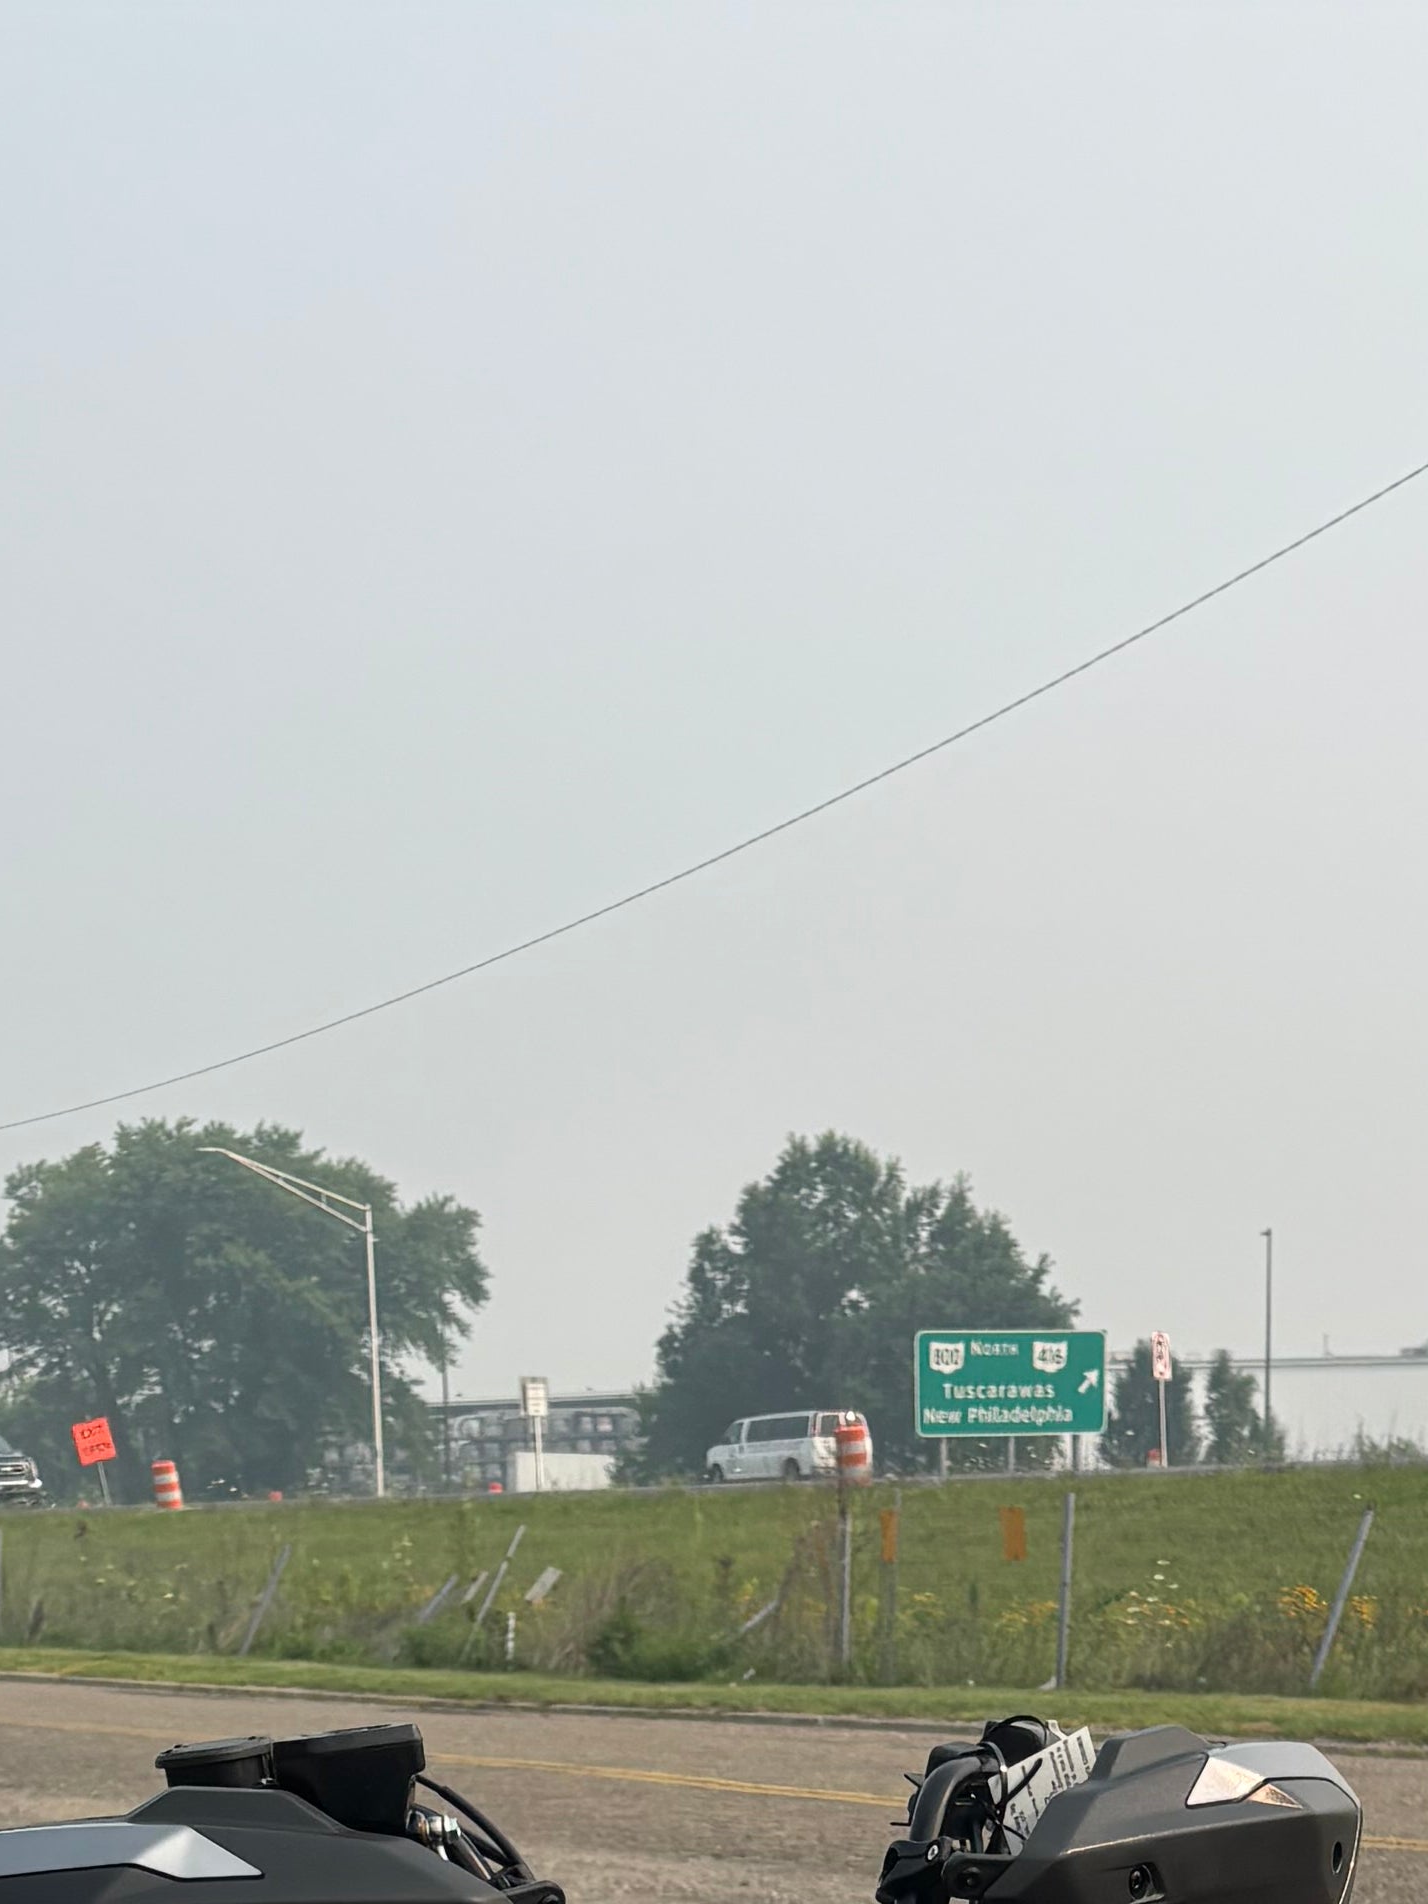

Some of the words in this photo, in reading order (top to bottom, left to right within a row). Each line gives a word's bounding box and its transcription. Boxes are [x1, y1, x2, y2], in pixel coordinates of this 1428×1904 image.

[942, 1383, 1055, 1399] Tuscarawas
[923, 1408, 962, 1424] New
[967, 1405, 1073, 1426] Philadelphia
